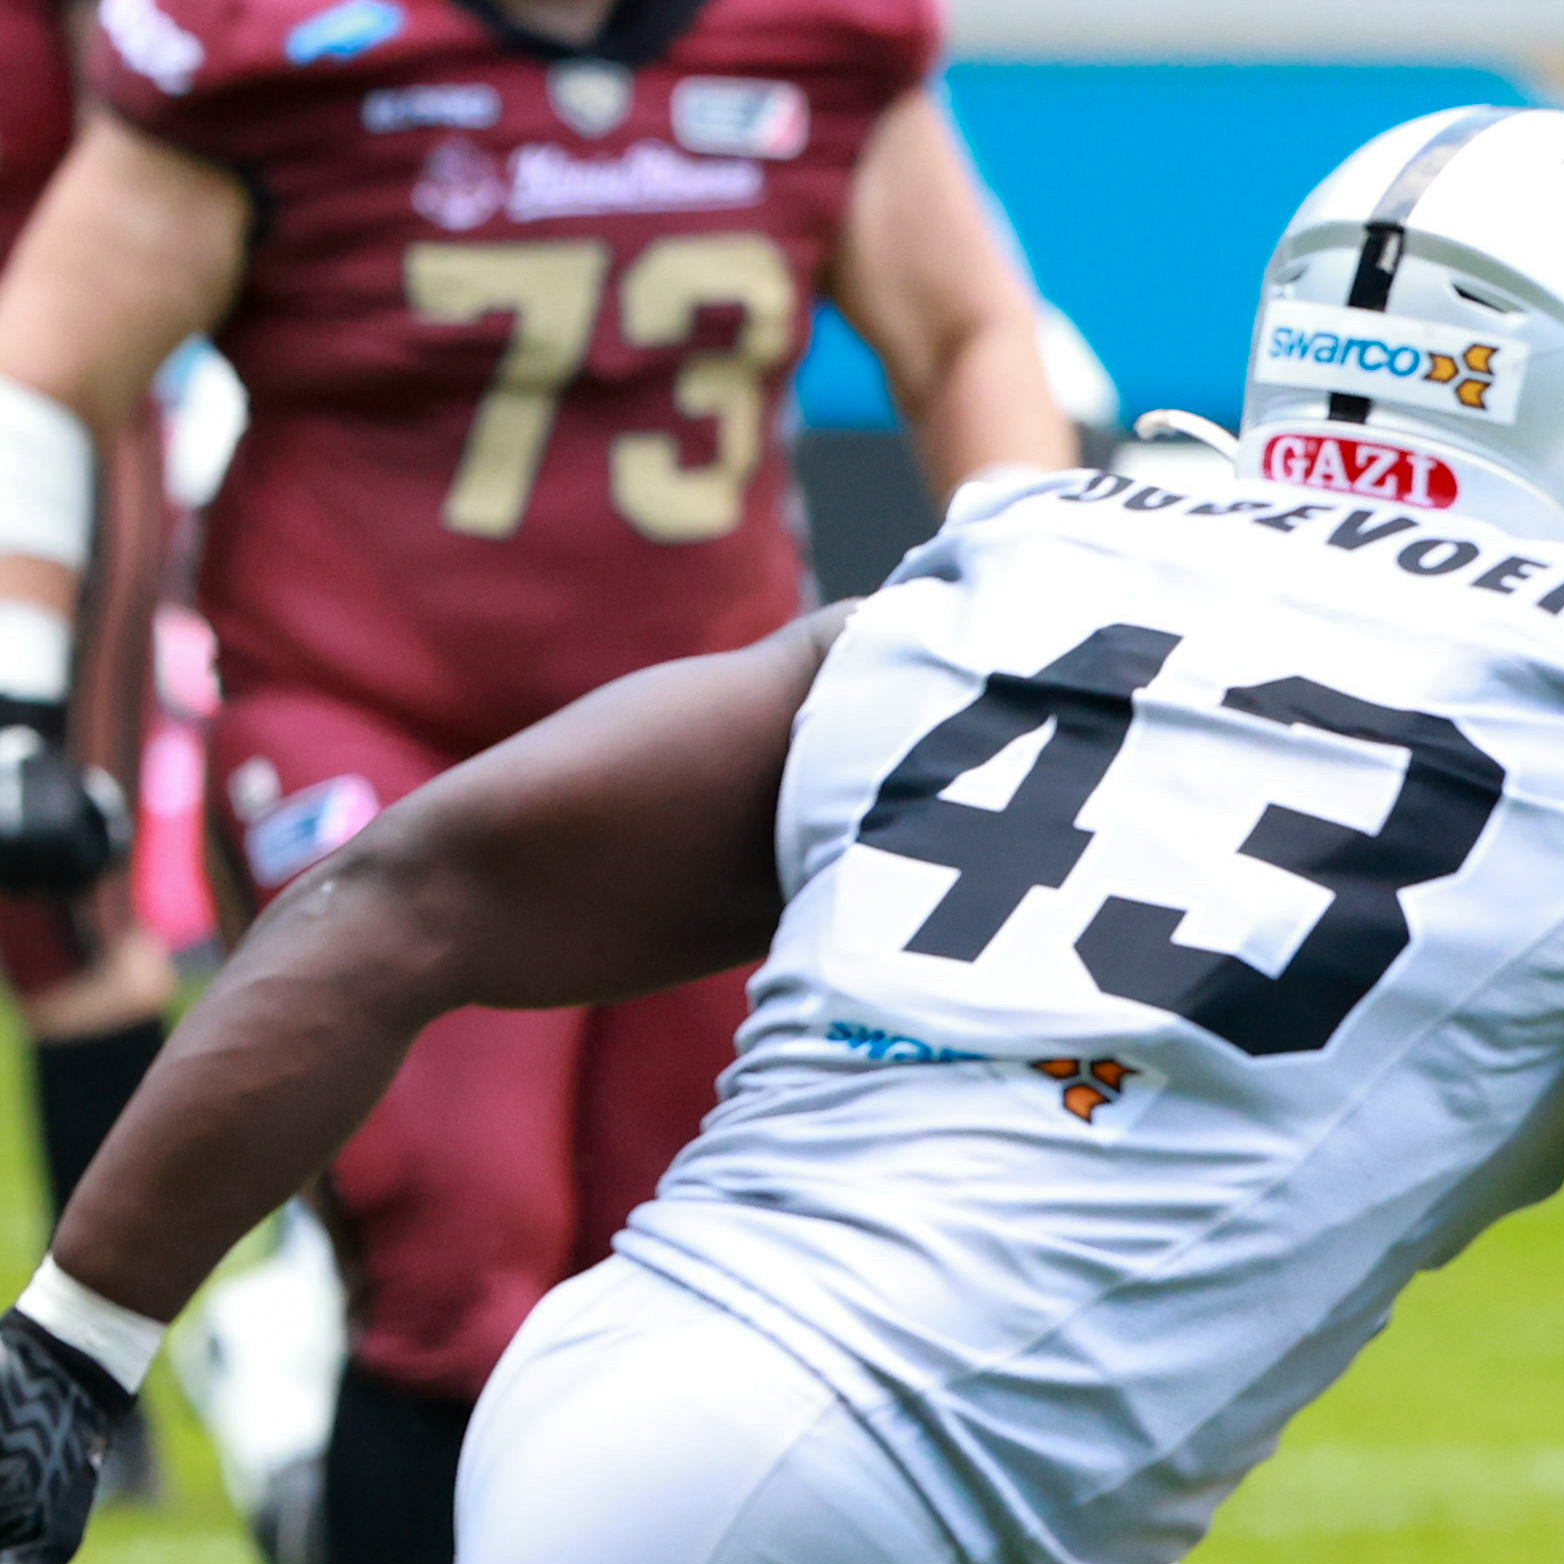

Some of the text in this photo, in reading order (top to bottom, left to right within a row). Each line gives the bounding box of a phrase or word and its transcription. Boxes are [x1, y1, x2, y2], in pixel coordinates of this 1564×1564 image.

[403, 232, 796, 542] 73
[1269, 327, 1420, 376] swarco
[1271, 437, 1434, 506] GAZI
[855, 620, 1508, 1058] 43
